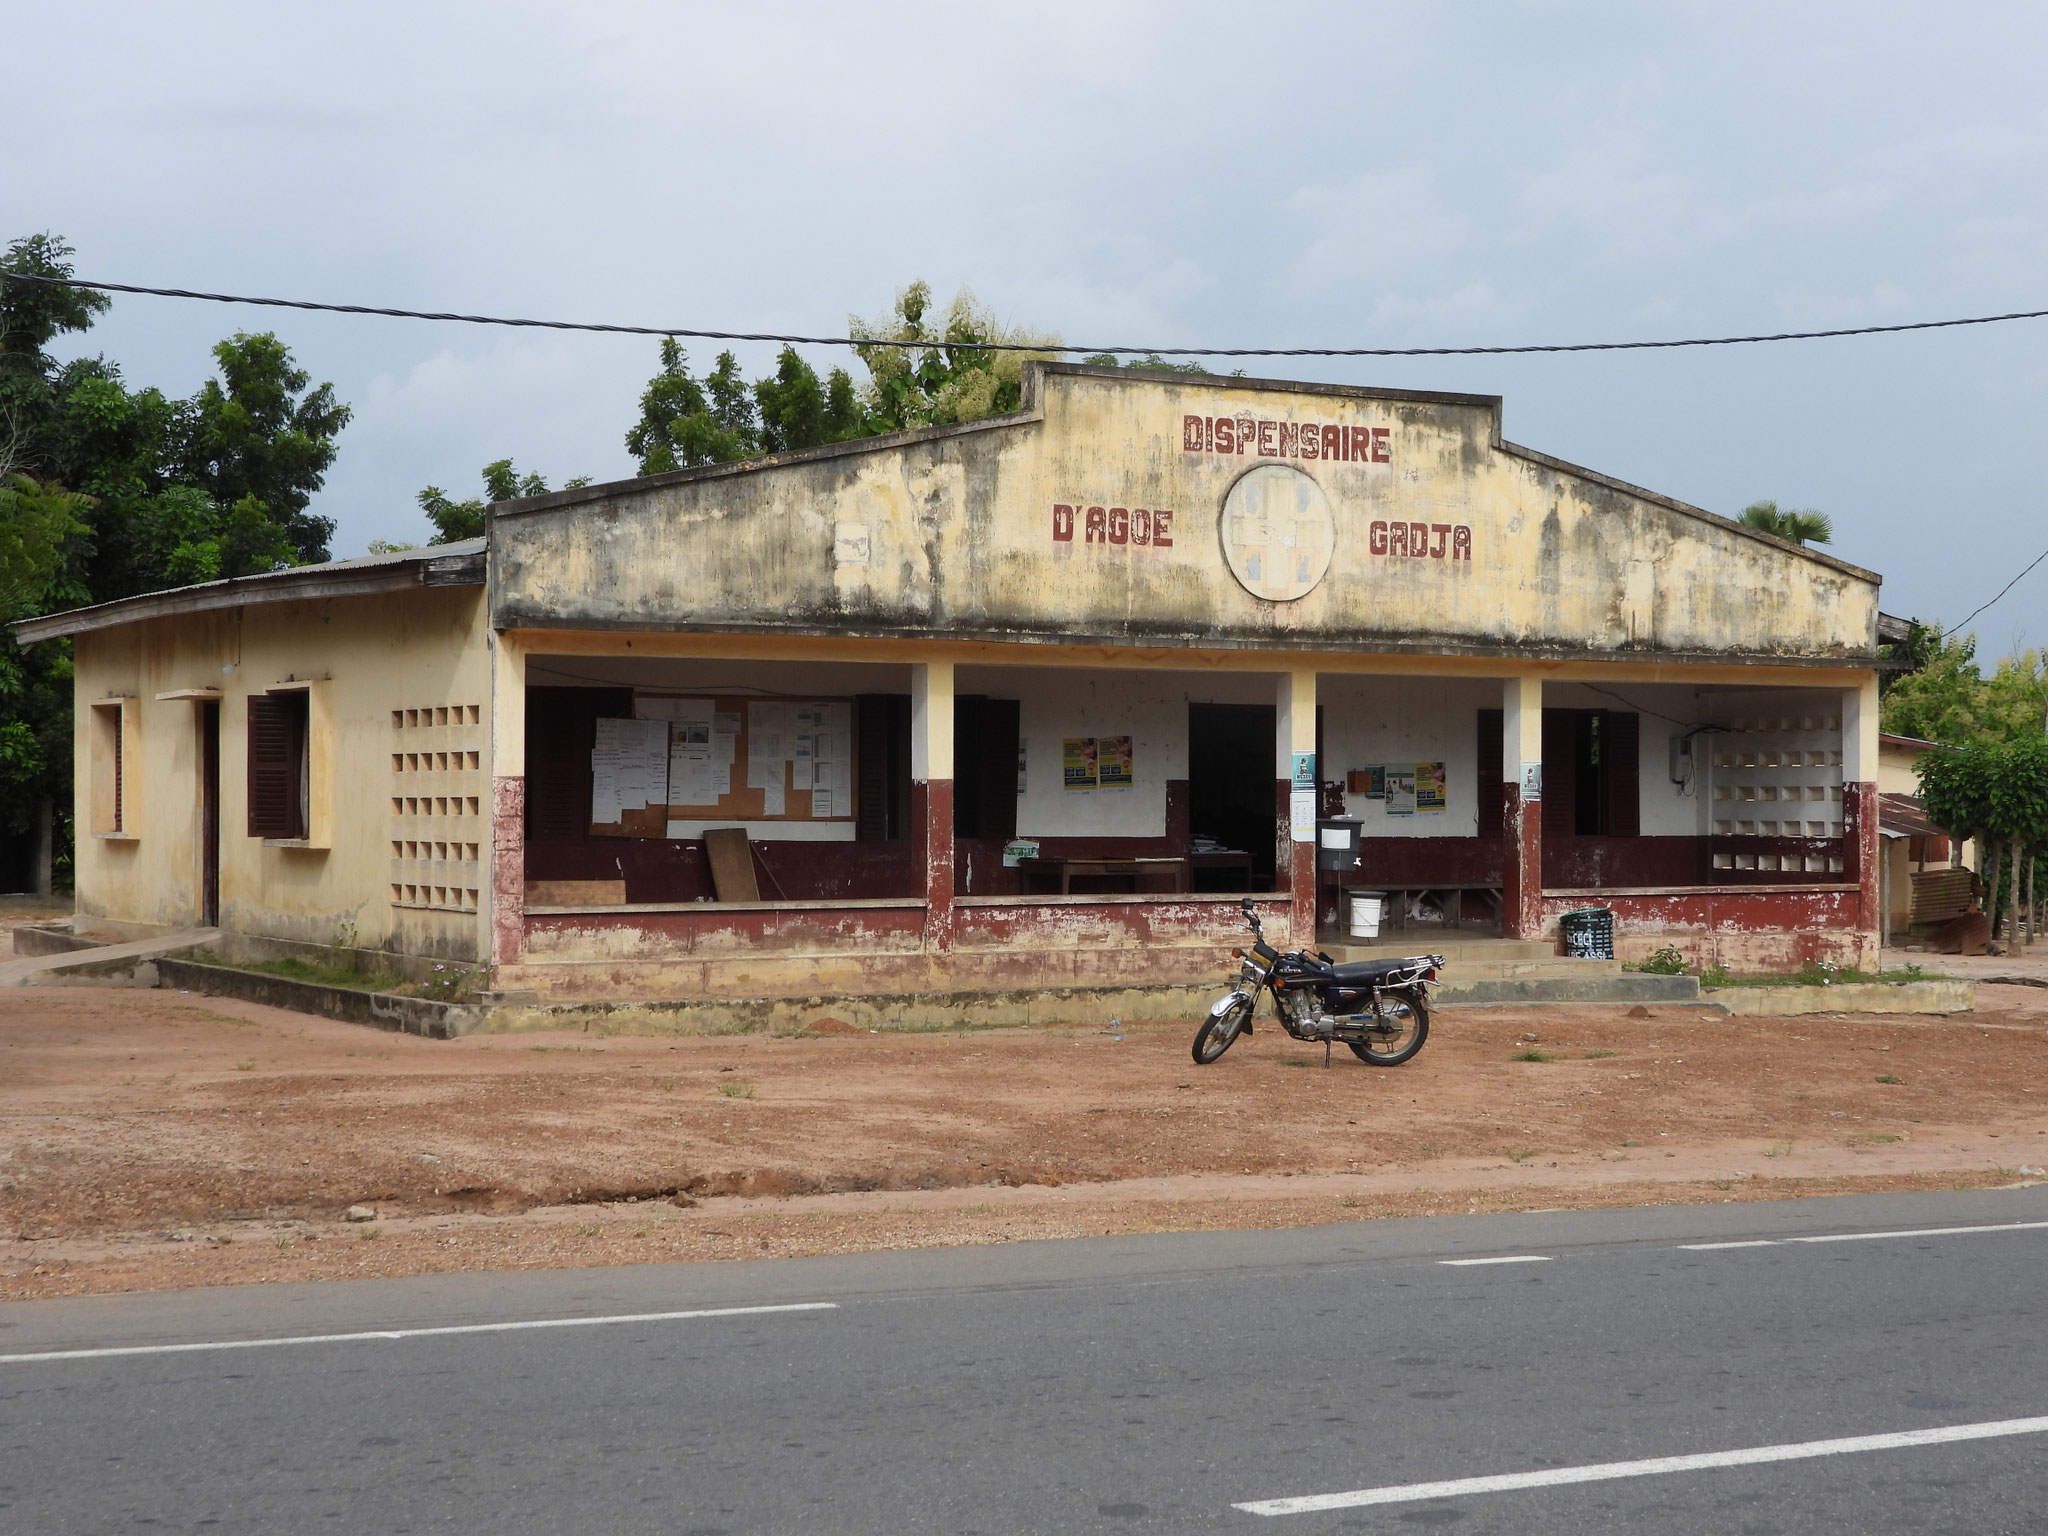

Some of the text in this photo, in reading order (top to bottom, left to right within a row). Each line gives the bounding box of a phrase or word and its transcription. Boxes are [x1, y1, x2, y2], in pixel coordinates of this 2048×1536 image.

[1183, 414, 1390, 463] DISPENSAIRE
[1052, 504, 1472, 560] D'AGOE GADJA
